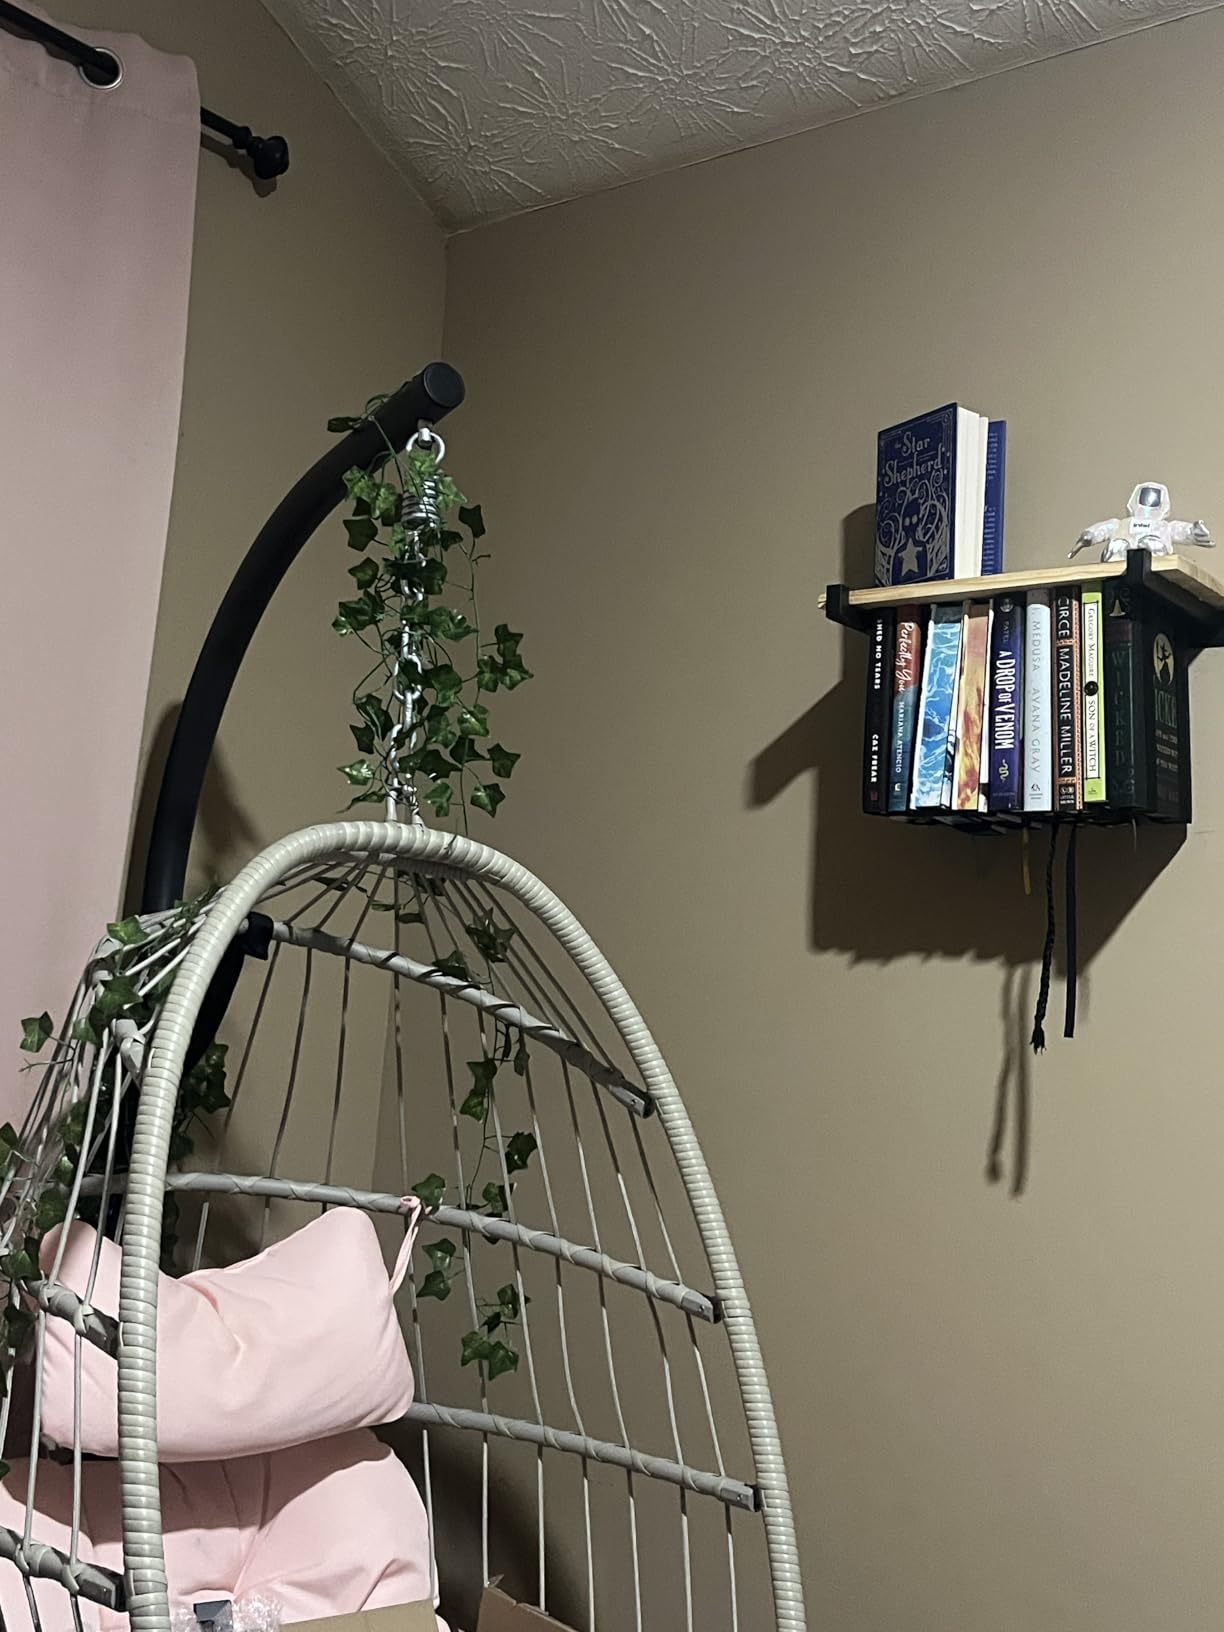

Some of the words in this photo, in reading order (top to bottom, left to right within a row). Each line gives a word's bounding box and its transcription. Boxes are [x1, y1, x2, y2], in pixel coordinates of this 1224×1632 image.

[903, 431, 931, 457] Star
[884, 443, 943, 488] Shepherd
[1058, 595, 1070, 638] CIRCE
[1087, 608, 1096, 640] GREGORY
[875, 645, 882, 659] NO
[895, 622, 914, 666] Perfectly
[1031, 620, 1041, 672] MEDUSA
[1087, 642, 1096, 677] MAGUIRE
[874, 662, 882, 689] TEARS
[895, 669, 912, 694] You
[994, 658, 1016, 692] DROP
[1059, 648, 1072, 721] MADELINE
[998, 693, 1012, 703] OF
[1031, 688, 1041, 732] AVANA
[1088, 700, 1096, 720] SON
[994, 703, 1016, 750] VENOM
[895, 740, 903, 773] ATENCIO
[1031, 738, 1041, 773] GRAY
[1060, 726, 1073, 774] MILLER
[1088, 739, 1097, 772] WITCH
